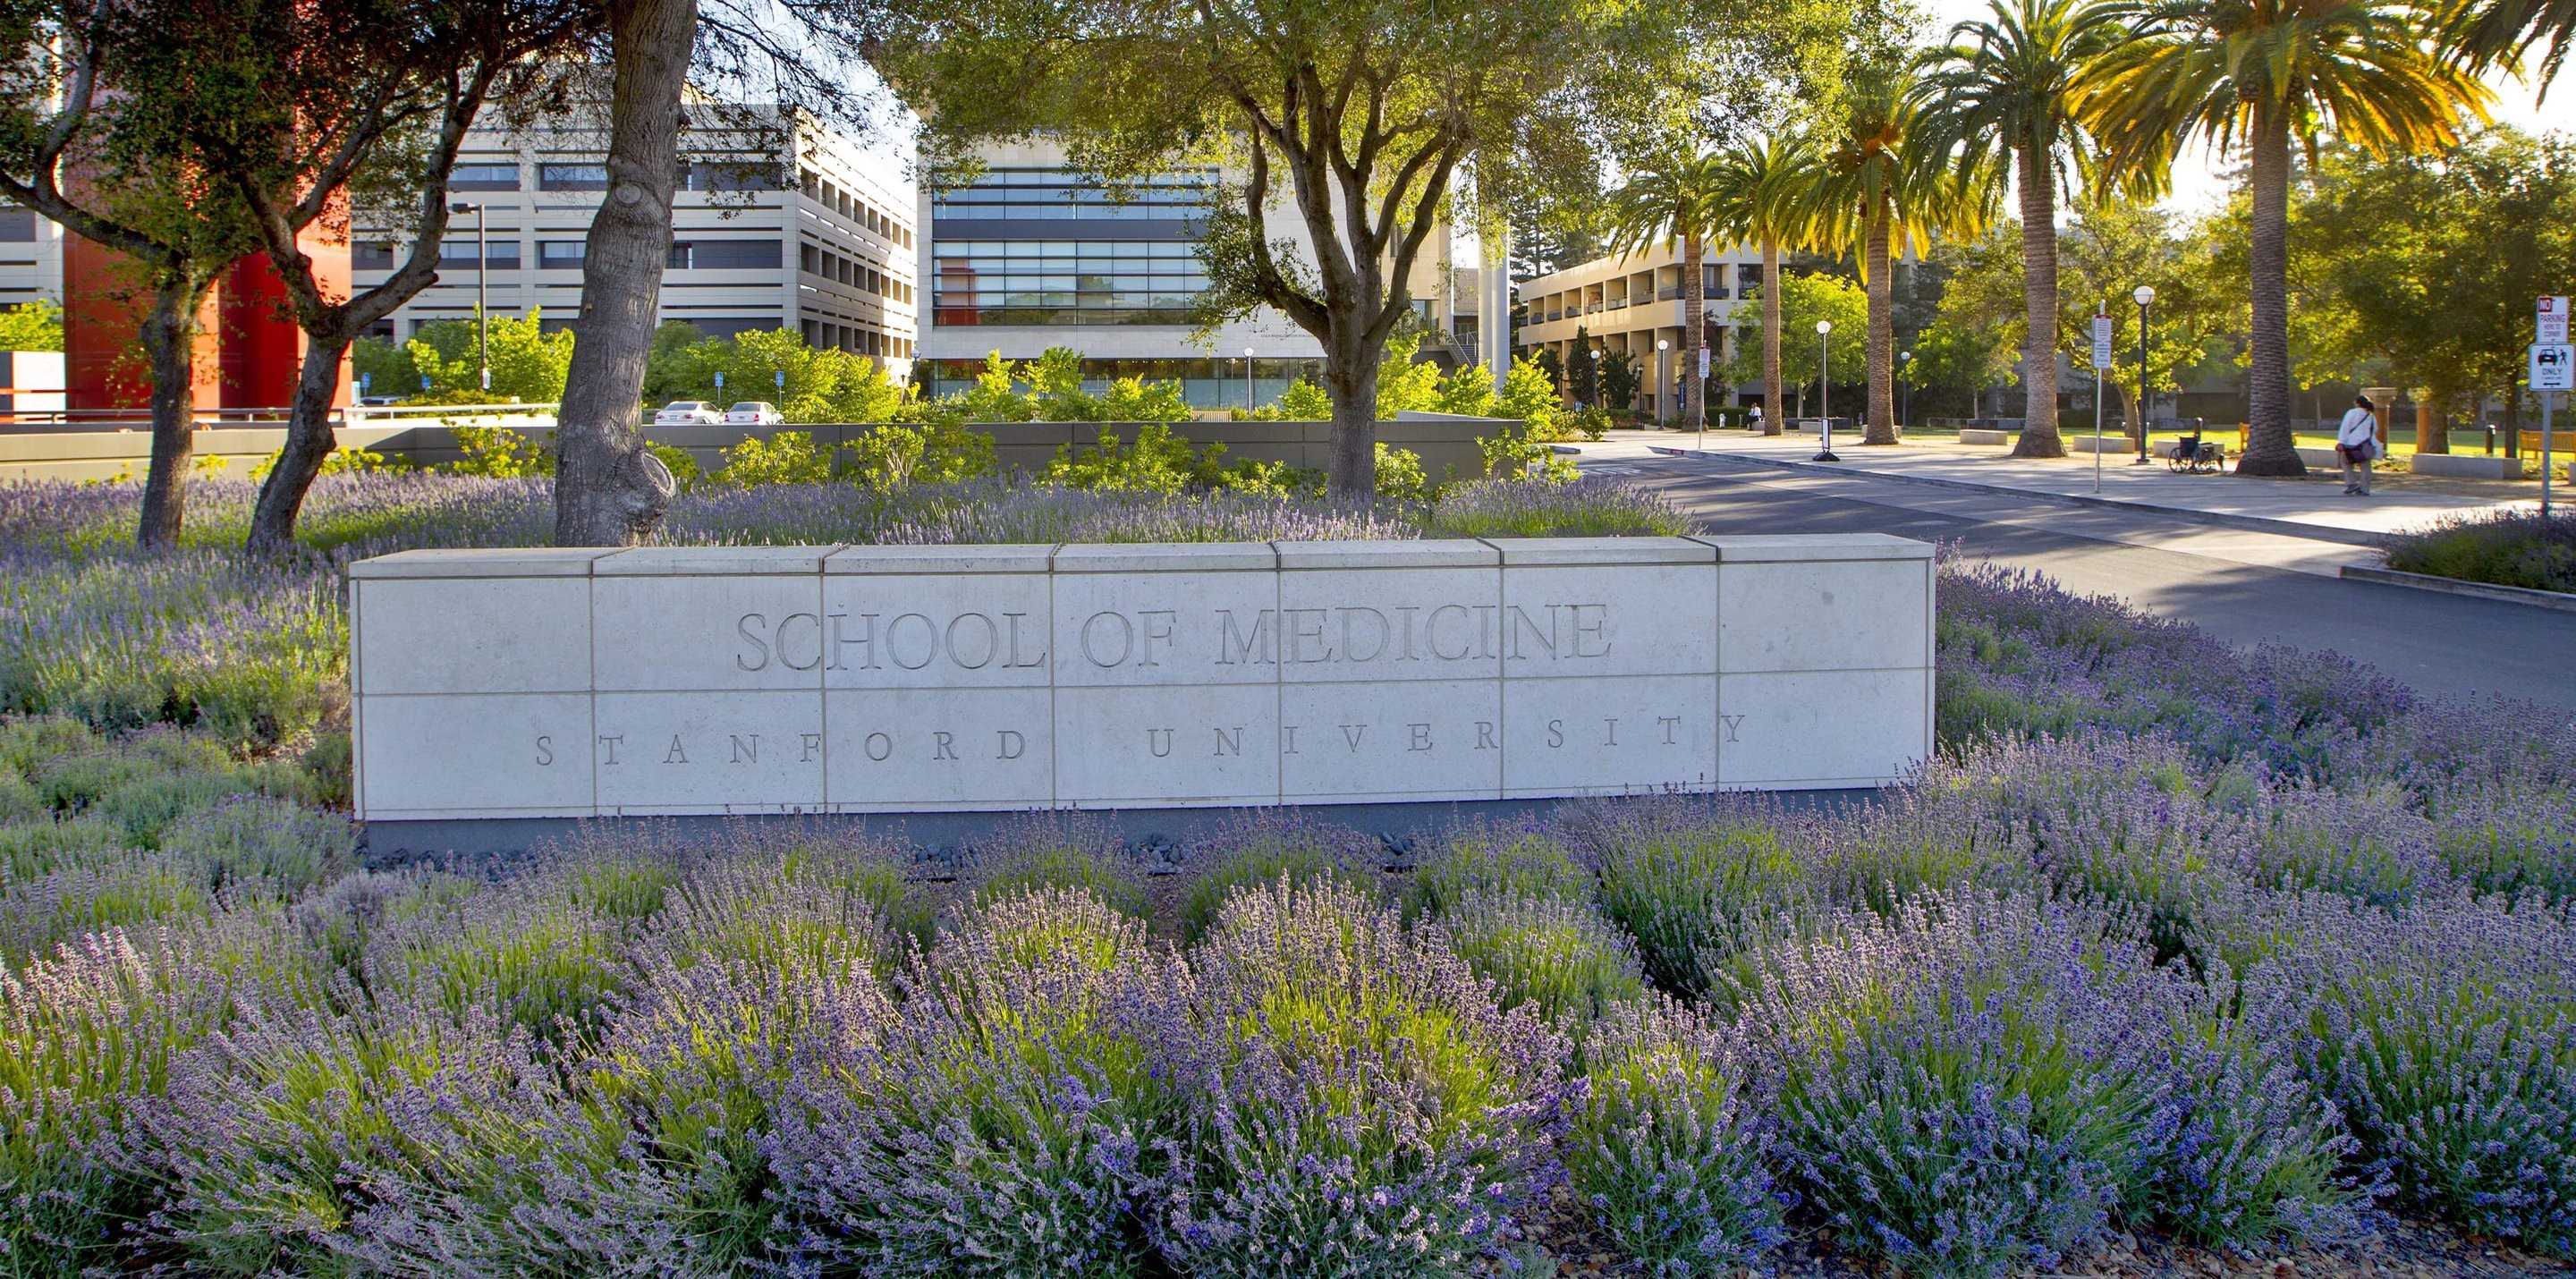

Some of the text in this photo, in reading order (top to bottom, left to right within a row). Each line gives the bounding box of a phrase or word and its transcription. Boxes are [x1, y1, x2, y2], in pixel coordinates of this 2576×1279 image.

[2539, 300, 2551, 311] NO
[2540, 314, 2565, 323] PARKING
[2541, 368, 2563, 376] ONLY
[736, 603, 1613, 672] SCHOOL OF MEDICINE
[536, 715, 1747, 767] STANFORD UNIVERSITY
